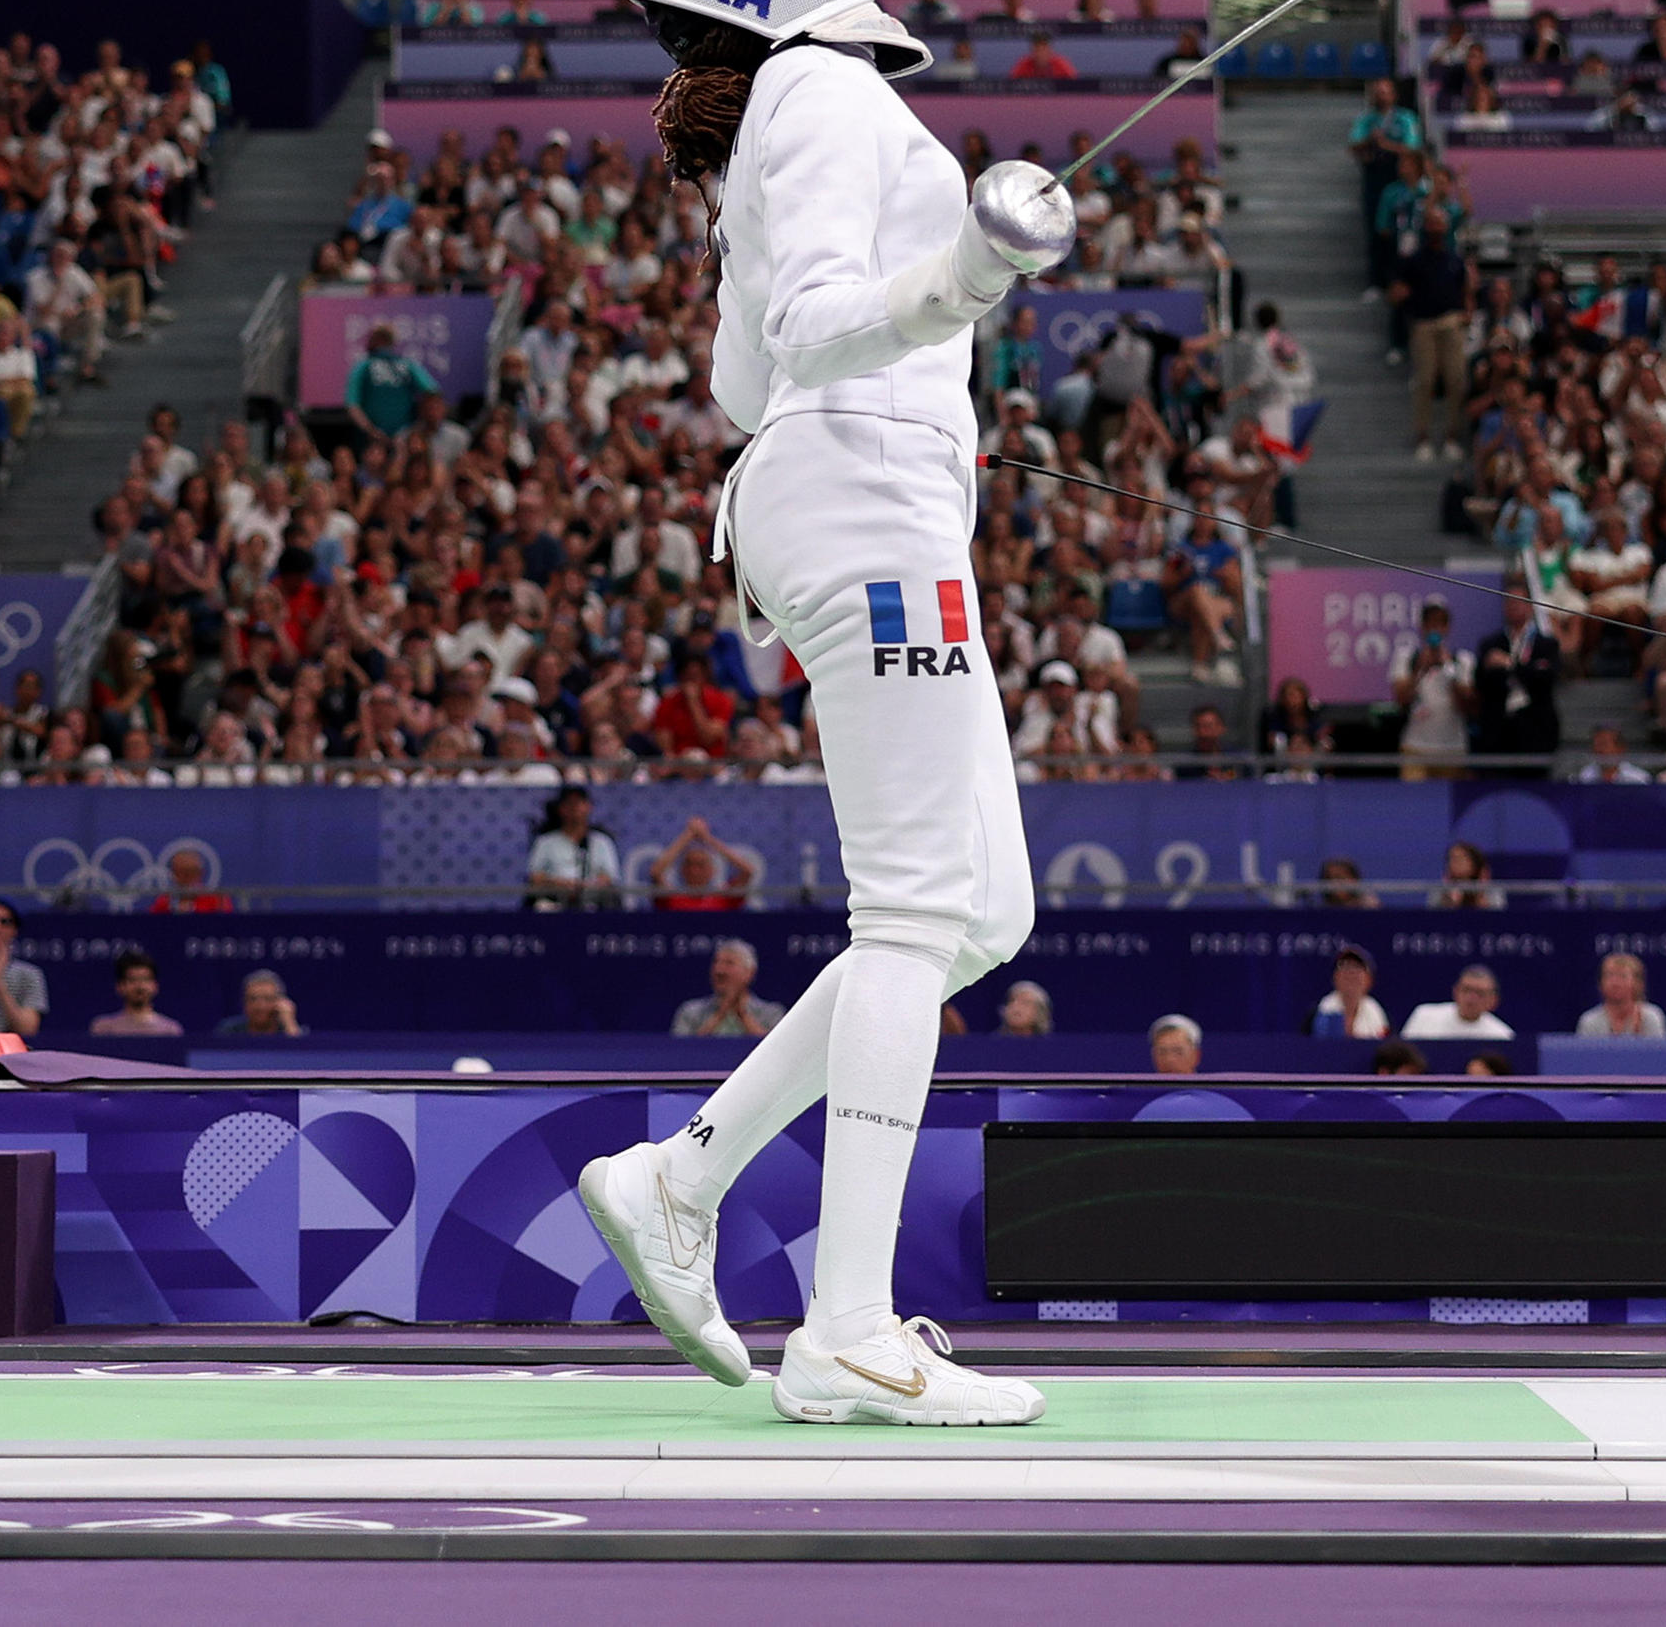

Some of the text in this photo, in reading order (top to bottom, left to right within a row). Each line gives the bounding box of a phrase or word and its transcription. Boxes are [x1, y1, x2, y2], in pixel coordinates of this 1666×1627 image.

[873, 646, 971, 677] FRA
[687, 1114, 715, 1148] RA
[836, 1108, 852, 1119] LE
[856, 1110, 883, 1125] COQ
